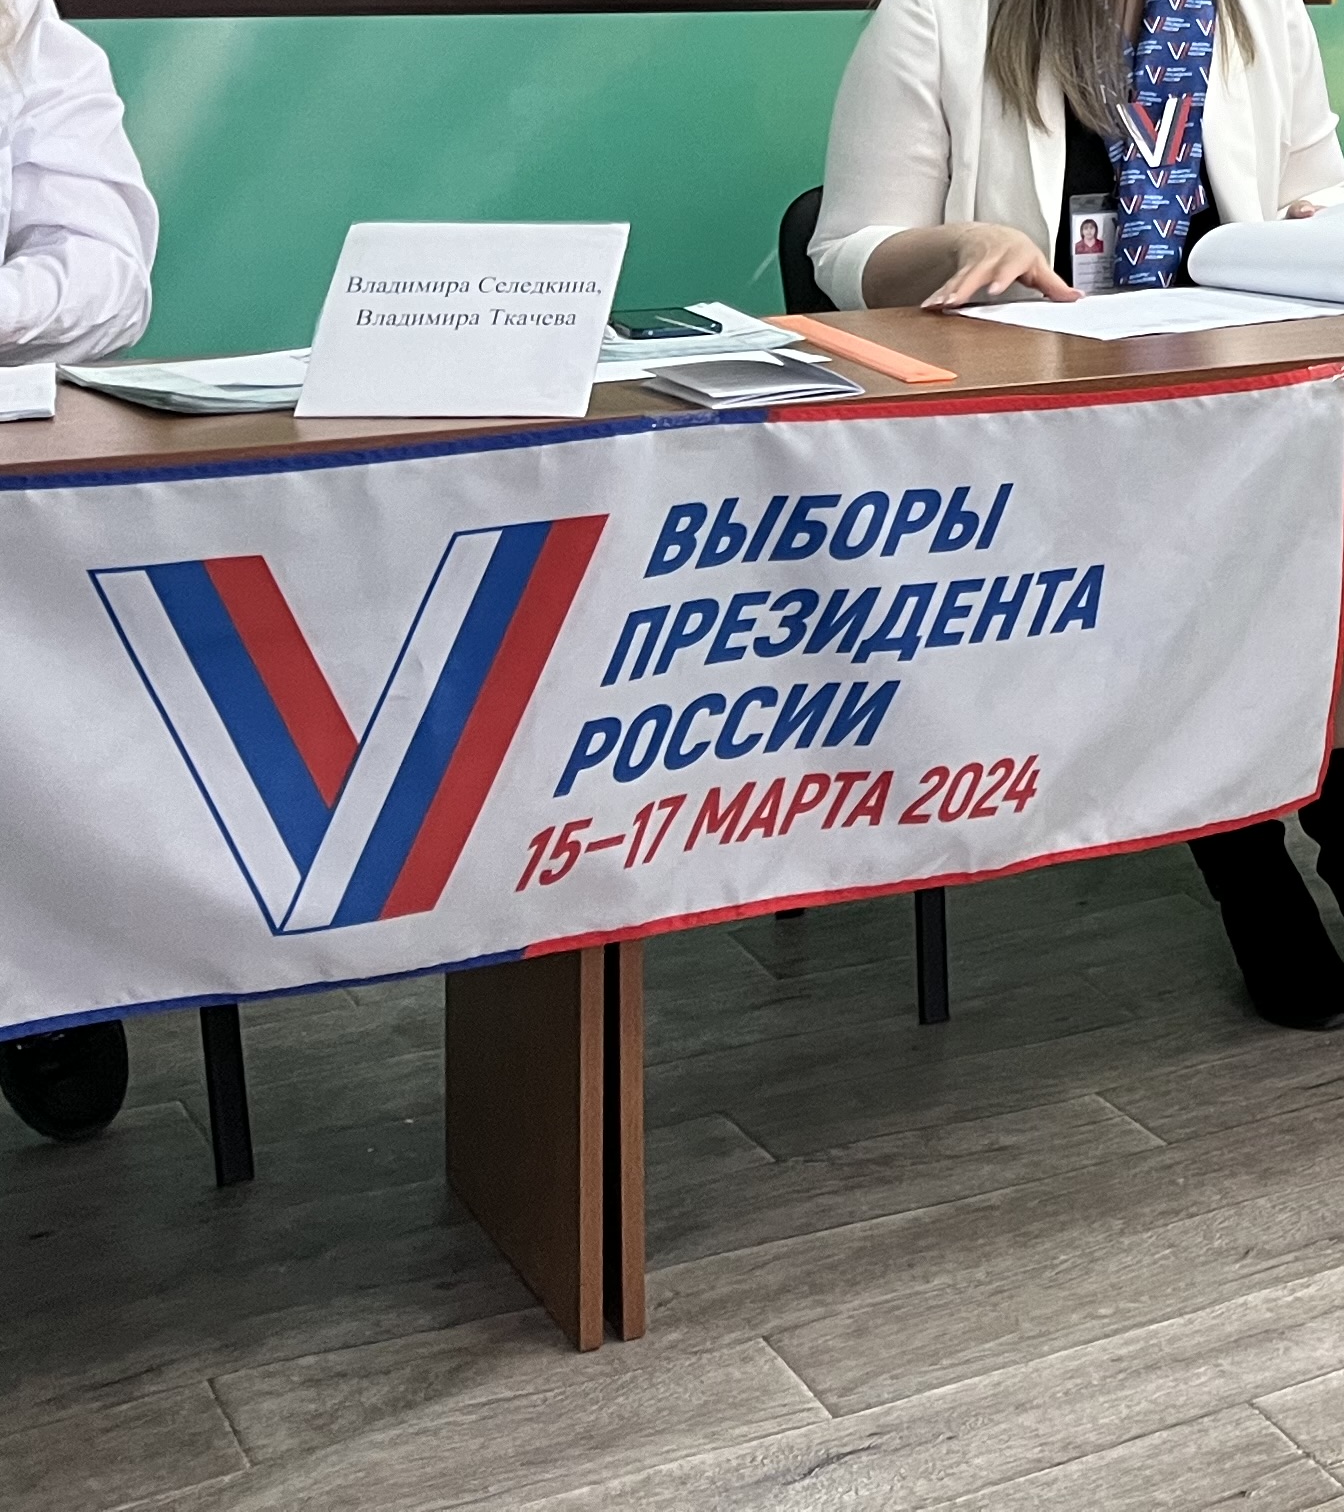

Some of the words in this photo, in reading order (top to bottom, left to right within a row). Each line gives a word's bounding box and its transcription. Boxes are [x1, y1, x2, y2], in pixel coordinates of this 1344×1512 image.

[345, 275, 470, 297] Владимира
[478, 275, 603, 296] Селедкина,
[356, 308, 480, 330] Владимира
[490, 308, 577, 326] Ткачева
[643, 483, 1014, 579] ВЫБОРЫ
[599, 564, 1105, 689] ПРЕЗИДЕНТА
[552, 679, 901, 798] РОССИИ
[684, 770, 895, 853] МАРТА
[898, 754, 1041, 827] 2024
